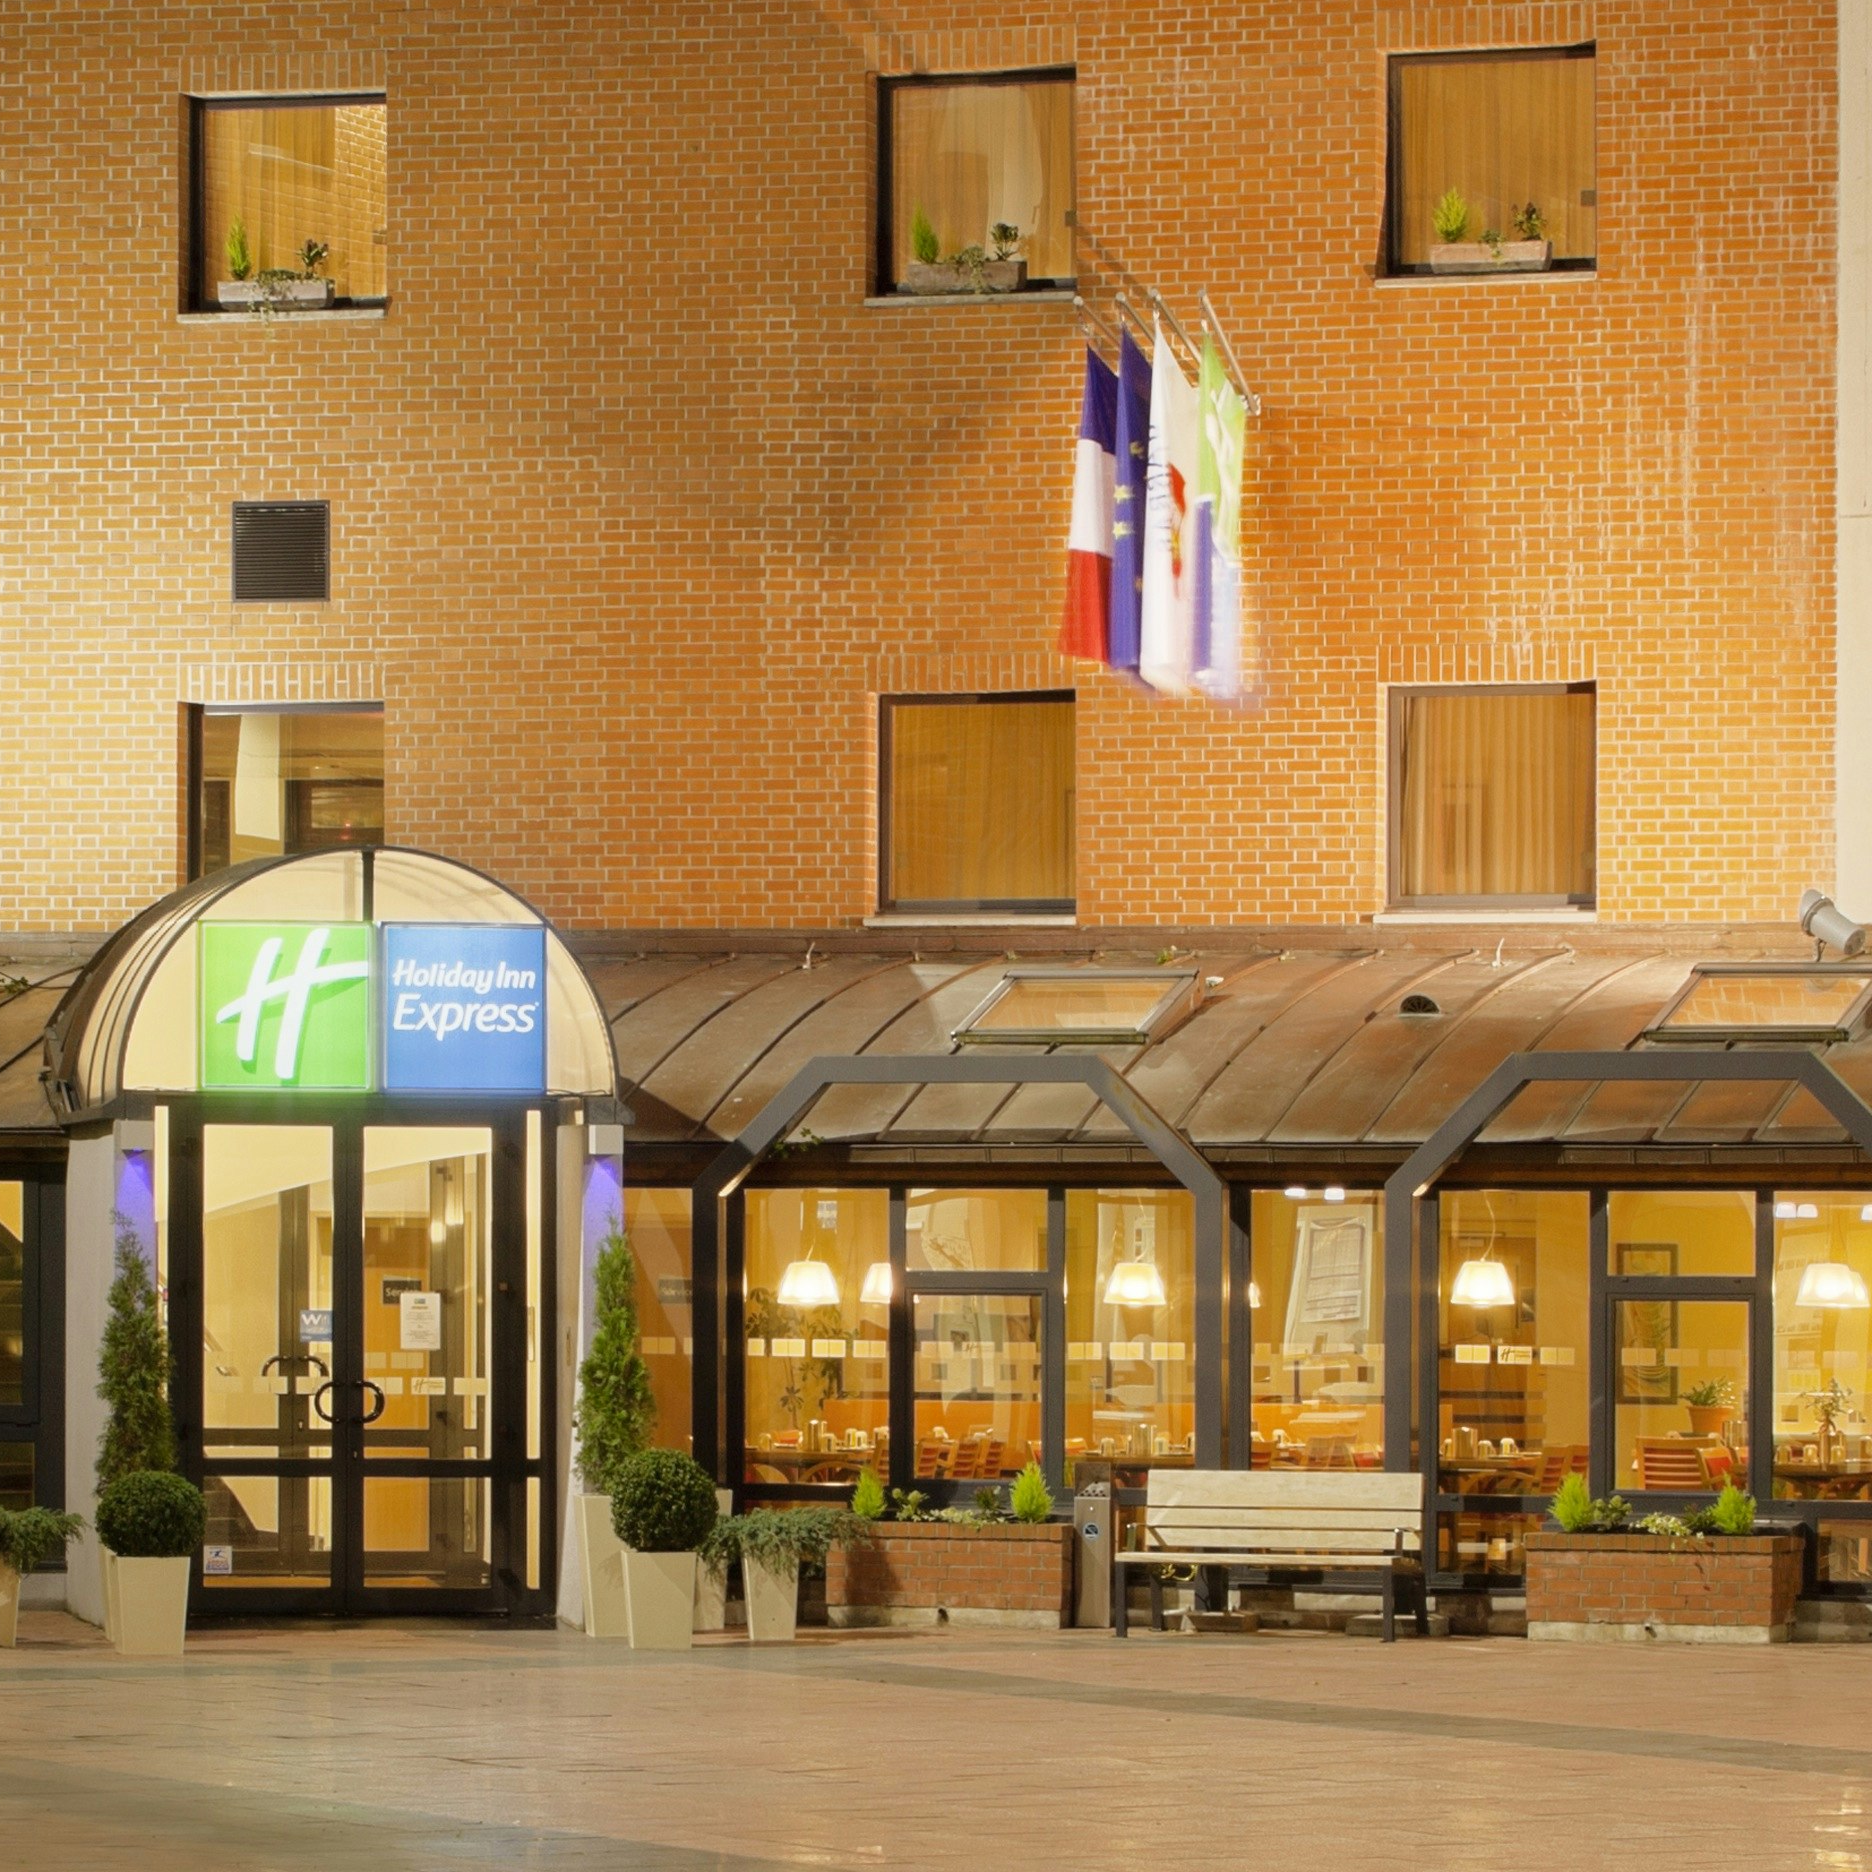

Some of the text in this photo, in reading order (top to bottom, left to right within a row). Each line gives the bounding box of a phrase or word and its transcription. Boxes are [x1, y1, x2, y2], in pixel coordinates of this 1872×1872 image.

[392, 959, 536, 994] Holiday Inn
[392, 994, 537, 1041] Express
